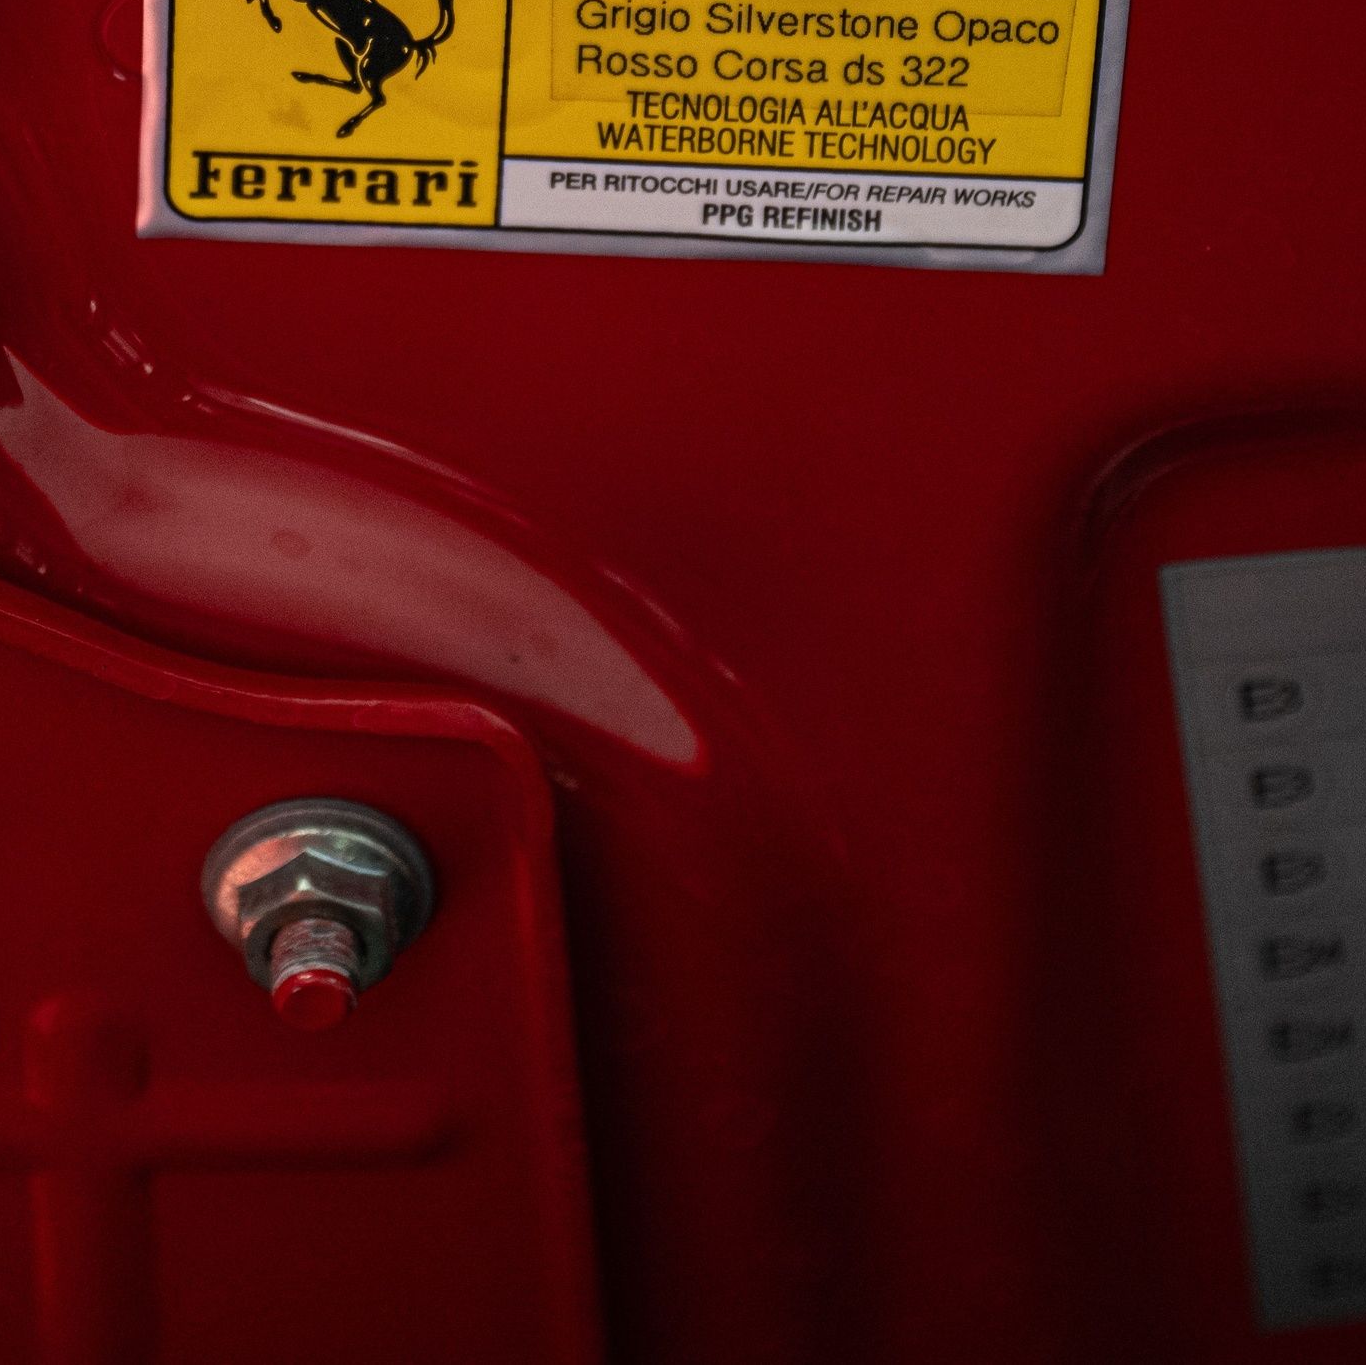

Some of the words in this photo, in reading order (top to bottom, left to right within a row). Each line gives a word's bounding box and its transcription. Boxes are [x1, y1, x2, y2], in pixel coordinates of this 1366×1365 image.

[706, 2, 919, 41] Silverstone
[934, 10, 1060, 47] Opaco
[577, 44, 698, 78] Rosso
[714, 49, 828, 84] Corsa
[843, 53, 886, 85] ds
[900, 55, 969, 87] 322
[627, 90, 806, 126] TECNOLOGIA
[816, 99, 969, 132] ALL'ACQUA
[598, 122, 796, 158] WATERBORNE
[805, 131, 996, 165] TECHNOLOGY
[189, 150, 479, 208] Ferrari
[550, 172, 597, 191] PER
[604, 174, 718, 195] RITOCCHI
[726, 179, 860, 201] USARE/FOR
[866, 184, 947, 205] REPAIR
[954, 188, 1037, 209] WORKS
[702, 203, 754, 228] PPG
[763, 205, 882, 232] REFINISH
